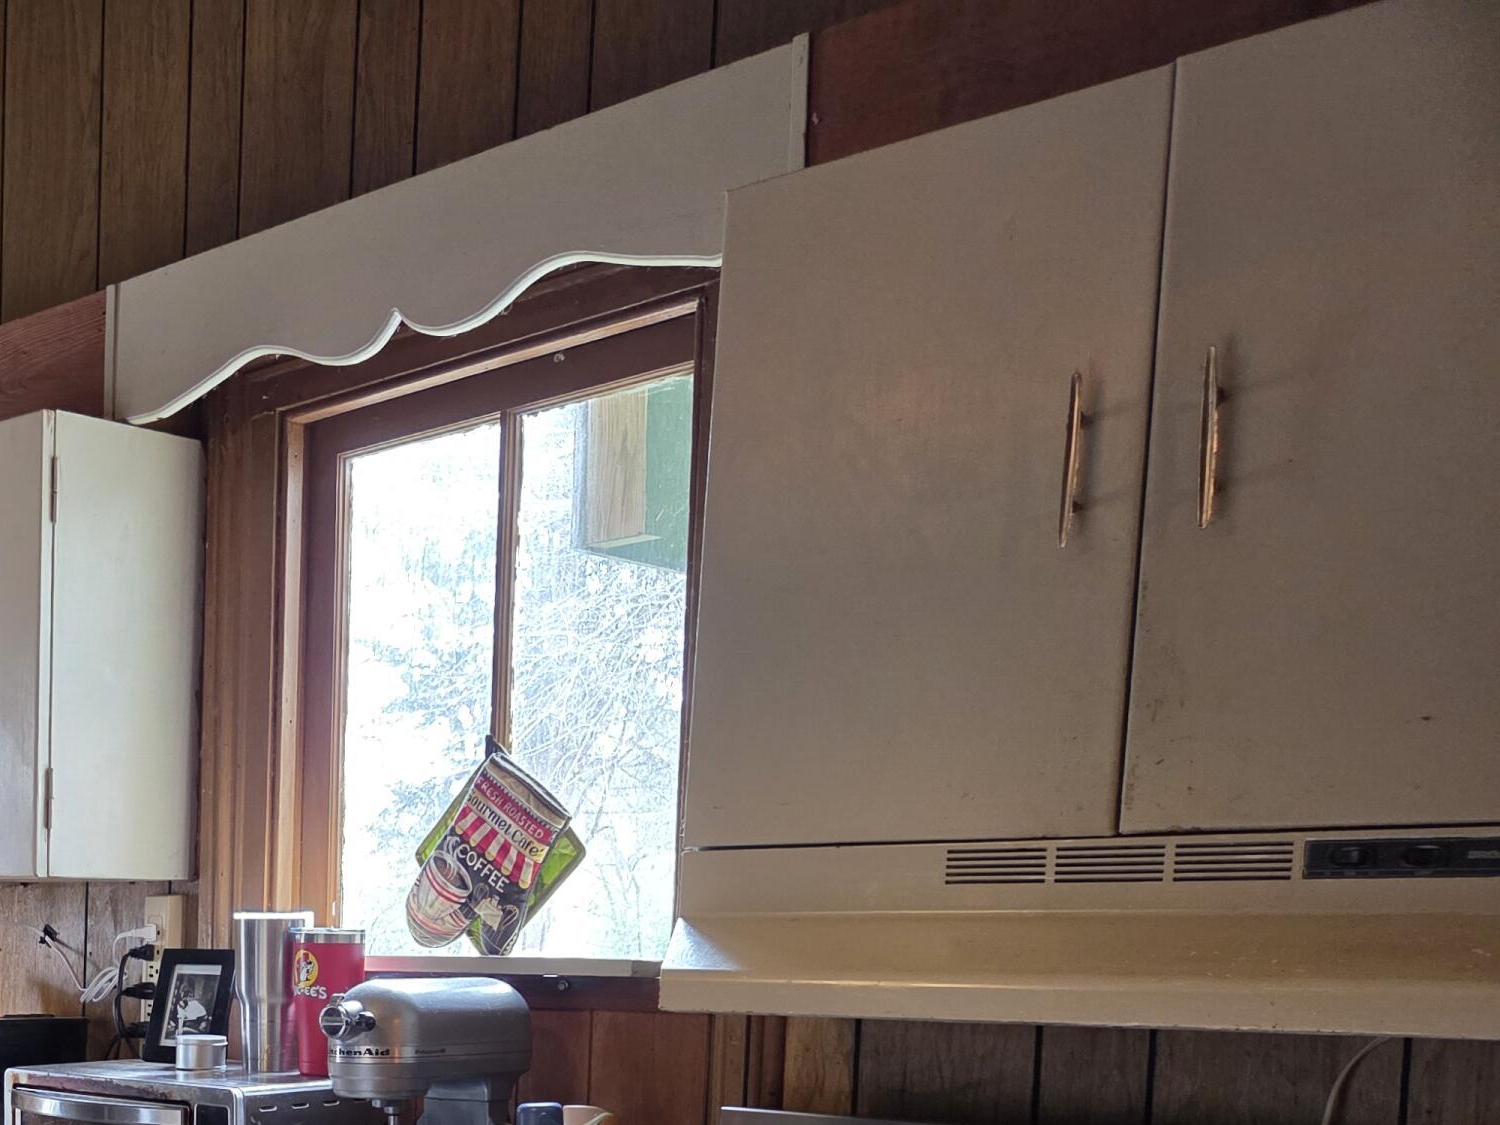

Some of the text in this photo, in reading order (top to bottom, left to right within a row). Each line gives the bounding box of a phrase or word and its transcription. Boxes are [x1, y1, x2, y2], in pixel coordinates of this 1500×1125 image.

[477, 776, 504, 807] FRESH
[502, 802, 545, 839] ROASTED
[511, 828, 545, 857] Café
[456, 843, 510, 894] COFFEE
[294, 985, 328, 1000] C-EE'S
[330, 1048, 390, 1056] tchenAid
